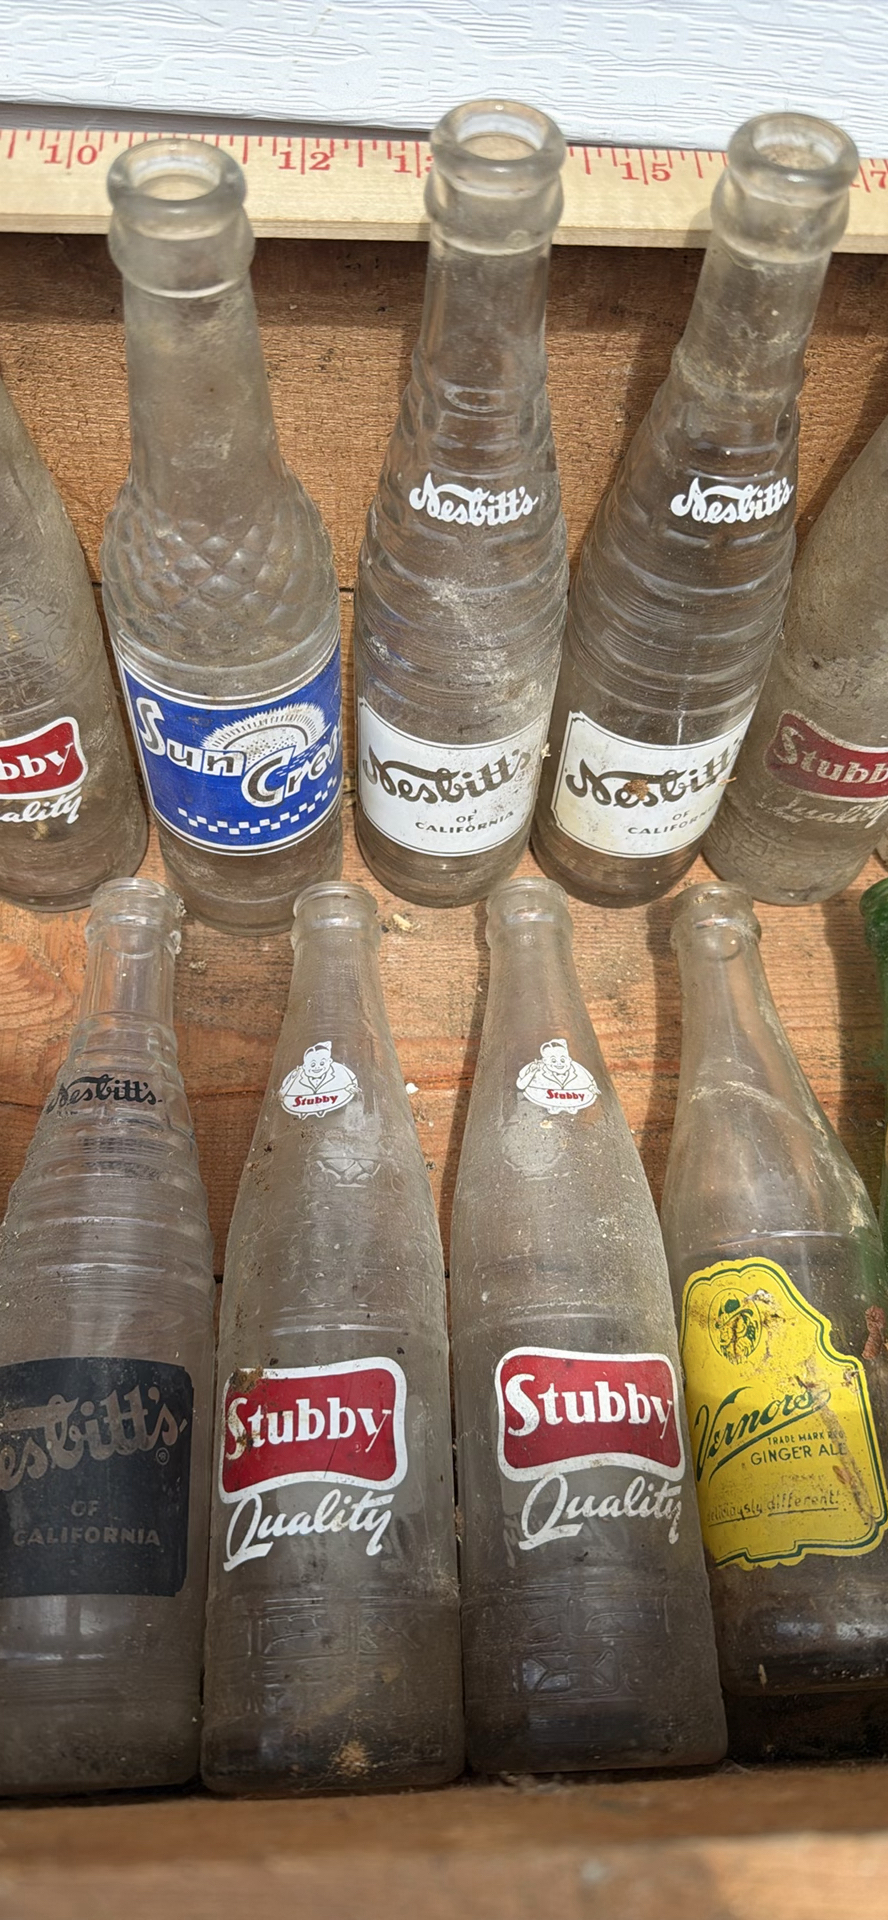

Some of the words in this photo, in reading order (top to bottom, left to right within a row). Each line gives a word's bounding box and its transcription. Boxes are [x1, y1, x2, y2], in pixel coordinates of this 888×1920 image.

[44, 144, 98, 166] 10
[278, 150, 331, 171] 12
[620, 162, 671, 182] 15
[408, 472, 539, 526] Nesbitt's
[670, 477, 794, 524] Nesbitt's
[136, 697, 246, 777] Sun
[362, 744, 538, 804] Nesbitt's
[415, 810, 515, 834] CALIFORNIA
[456, 814, 475, 823] OF
[672, 810, 691, 821] OF
[45, 1074, 163, 1114] Nesbitt's
[292, 1095, 339, 1108] Stubby
[546, 1089, 585, 1102] Stubby
[504, 1373, 673, 1440] Stubby
[0, 1384, 188, 1492] esbitt's
[226, 1396, 393, 1461] Stubby
[767, 1434, 795, 1446] TRADE
[798, 1431, 825, 1442] MARK
[750, 1445, 812, 1466] GINGER
[818, 1443, 847, 1457] ALE
[70, 1499, 99, 1517] OF
[518, 1473, 682, 1551] Quality
[13, 1526, 161, 1547] CALIFORNIA
[223, 1488, 395, 1572] Quality
